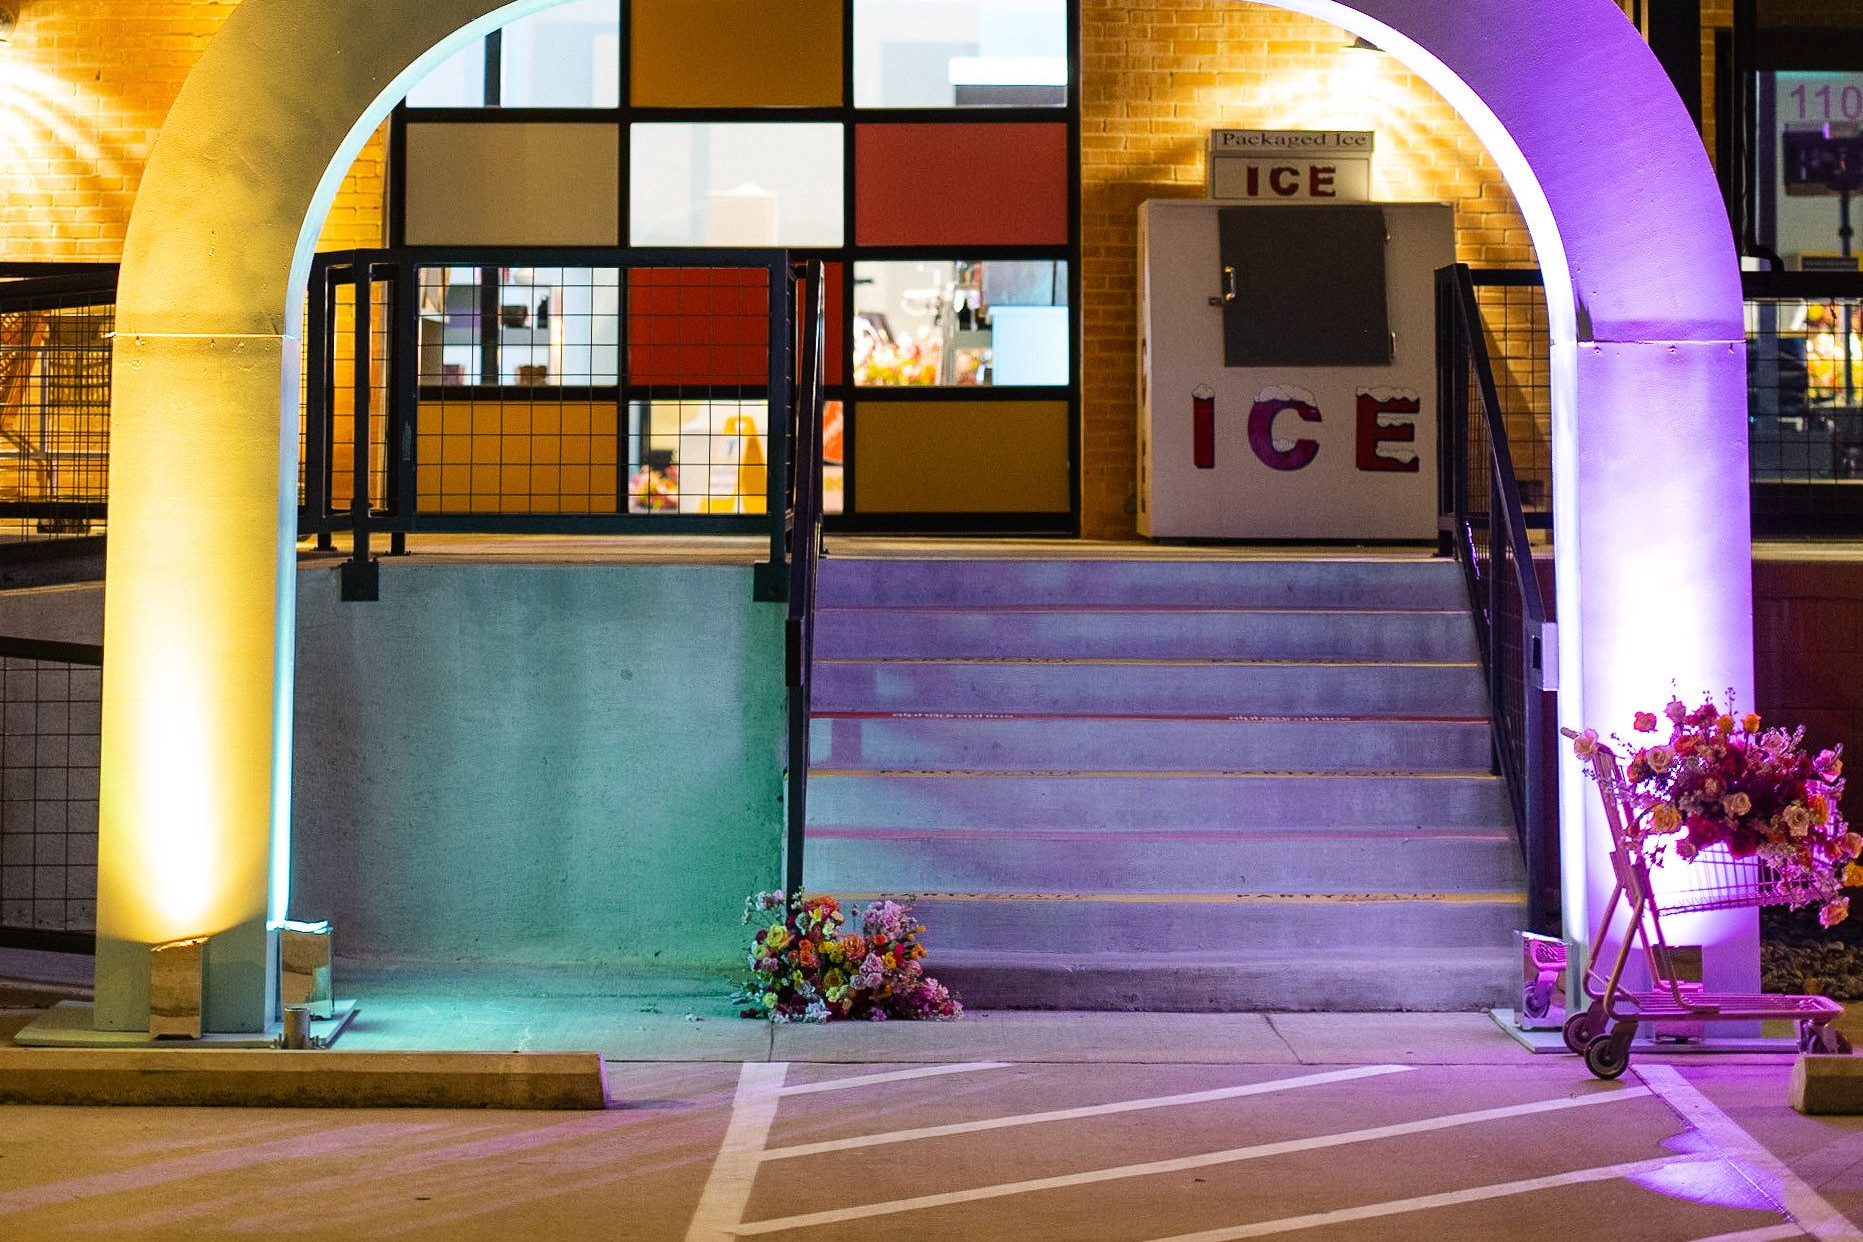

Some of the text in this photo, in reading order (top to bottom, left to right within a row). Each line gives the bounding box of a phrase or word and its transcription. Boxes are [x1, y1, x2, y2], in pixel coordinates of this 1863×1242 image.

[1223, 131, 1366, 148] Packaged Ice
[1246, 165, 1336, 197] ICE
[1191, 385, 1420, 472] ICE
